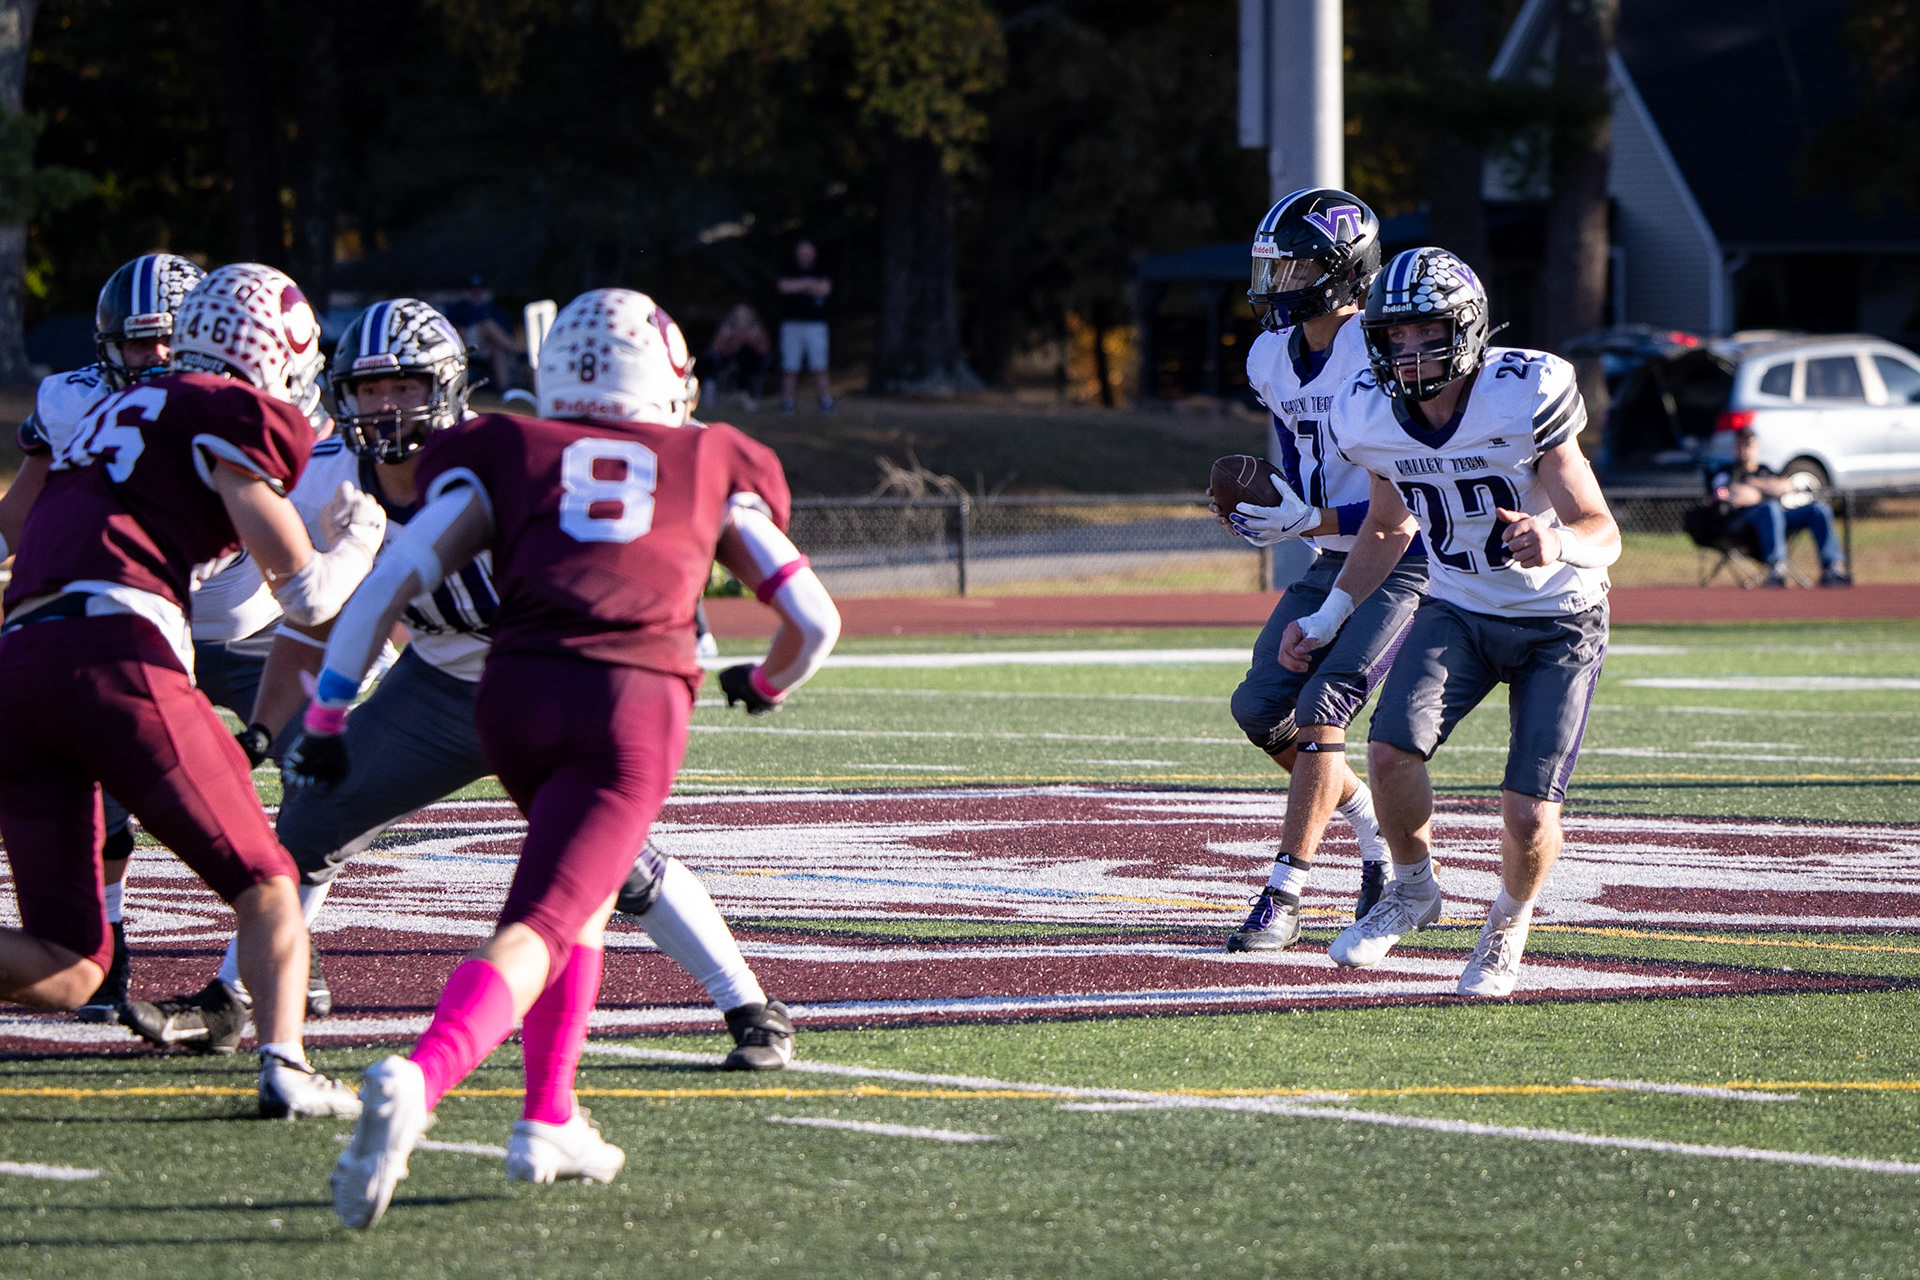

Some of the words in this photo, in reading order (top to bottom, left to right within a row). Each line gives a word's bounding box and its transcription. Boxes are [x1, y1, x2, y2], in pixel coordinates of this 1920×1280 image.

[1303, 204, 1362, 244] VT
[1253, 244, 1274, 255] Riddell
[1382, 304, 1412, 314] Riddell
[580, 352, 596, 383] 8
[553, 398, 626, 416] Riddell
[1394, 457, 1445, 476] VALLEY
[1450, 455, 1489, 474] TECH
[559, 437, 658, 544] 8
[1396, 475, 1522, 575] 22
